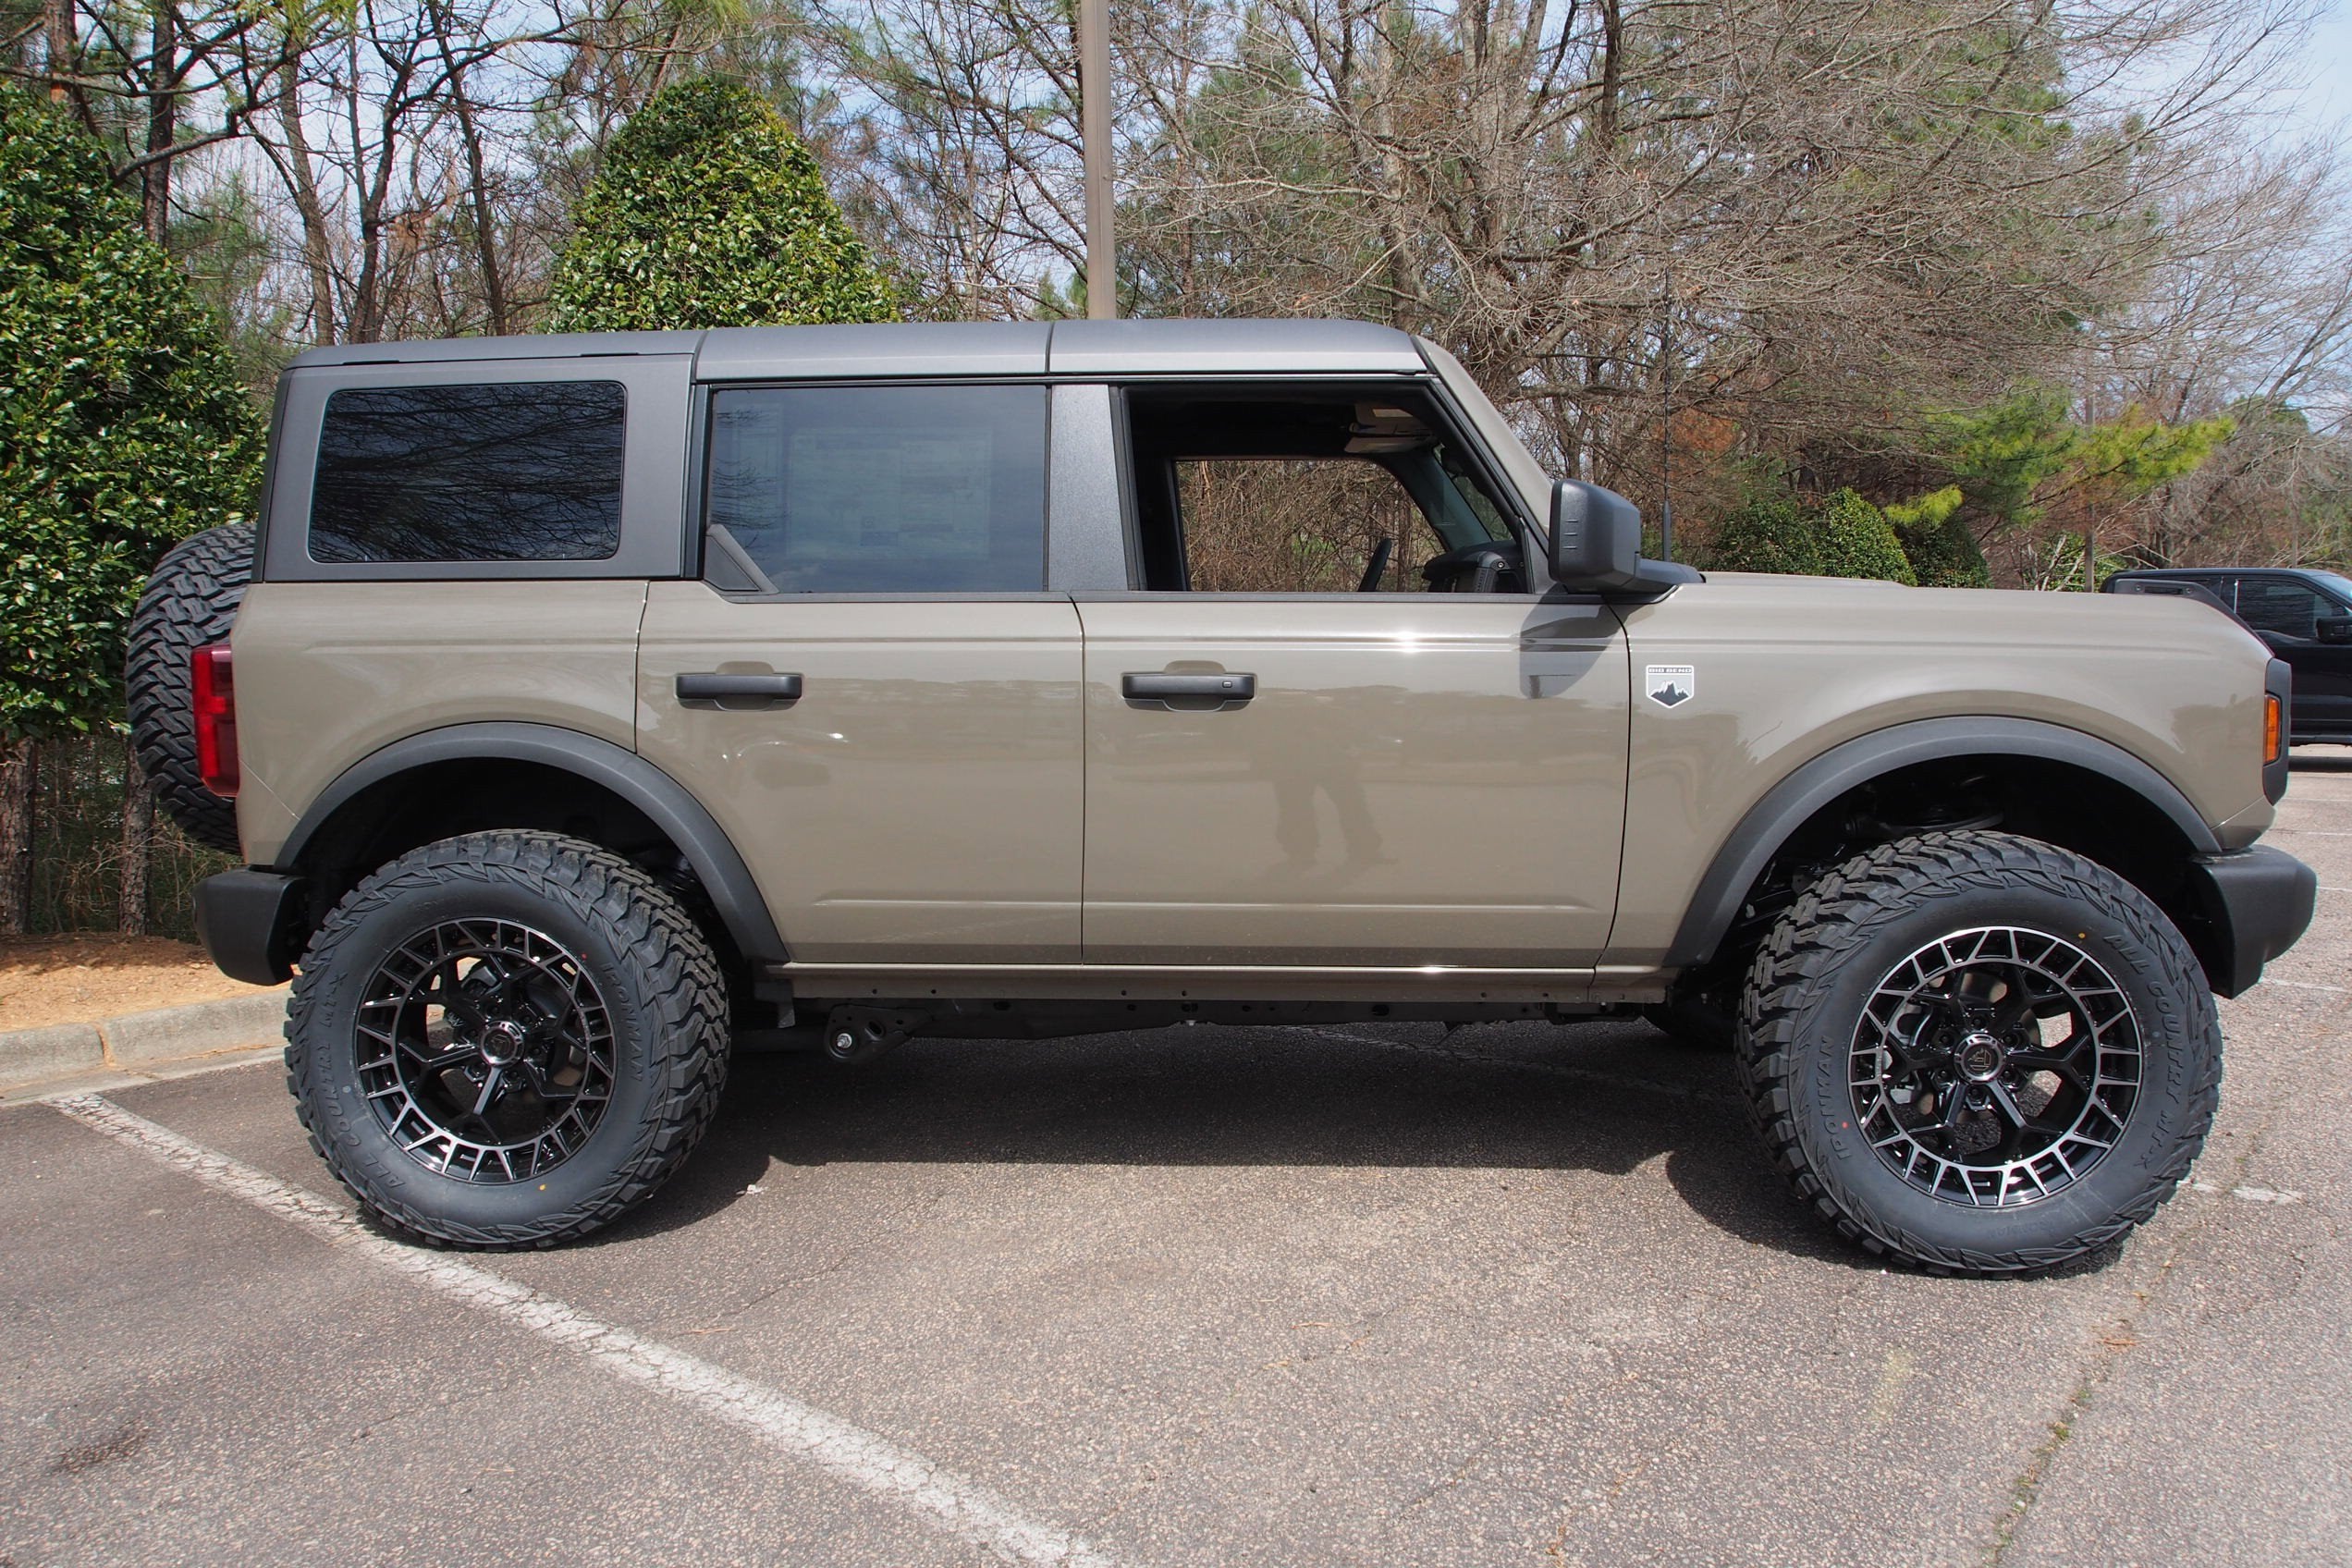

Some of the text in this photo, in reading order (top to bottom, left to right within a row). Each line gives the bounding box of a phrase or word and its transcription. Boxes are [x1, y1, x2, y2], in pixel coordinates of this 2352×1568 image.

[601, 962, 644, 1082] IRONMAN
[2102, 934, 2150, 974] ALL
[2147, 980, 2184, 1105] COUNTRY
[1816, 1035, 1852, 1160] IRONMAN
[362, 1158, 405, 1189] ALL
